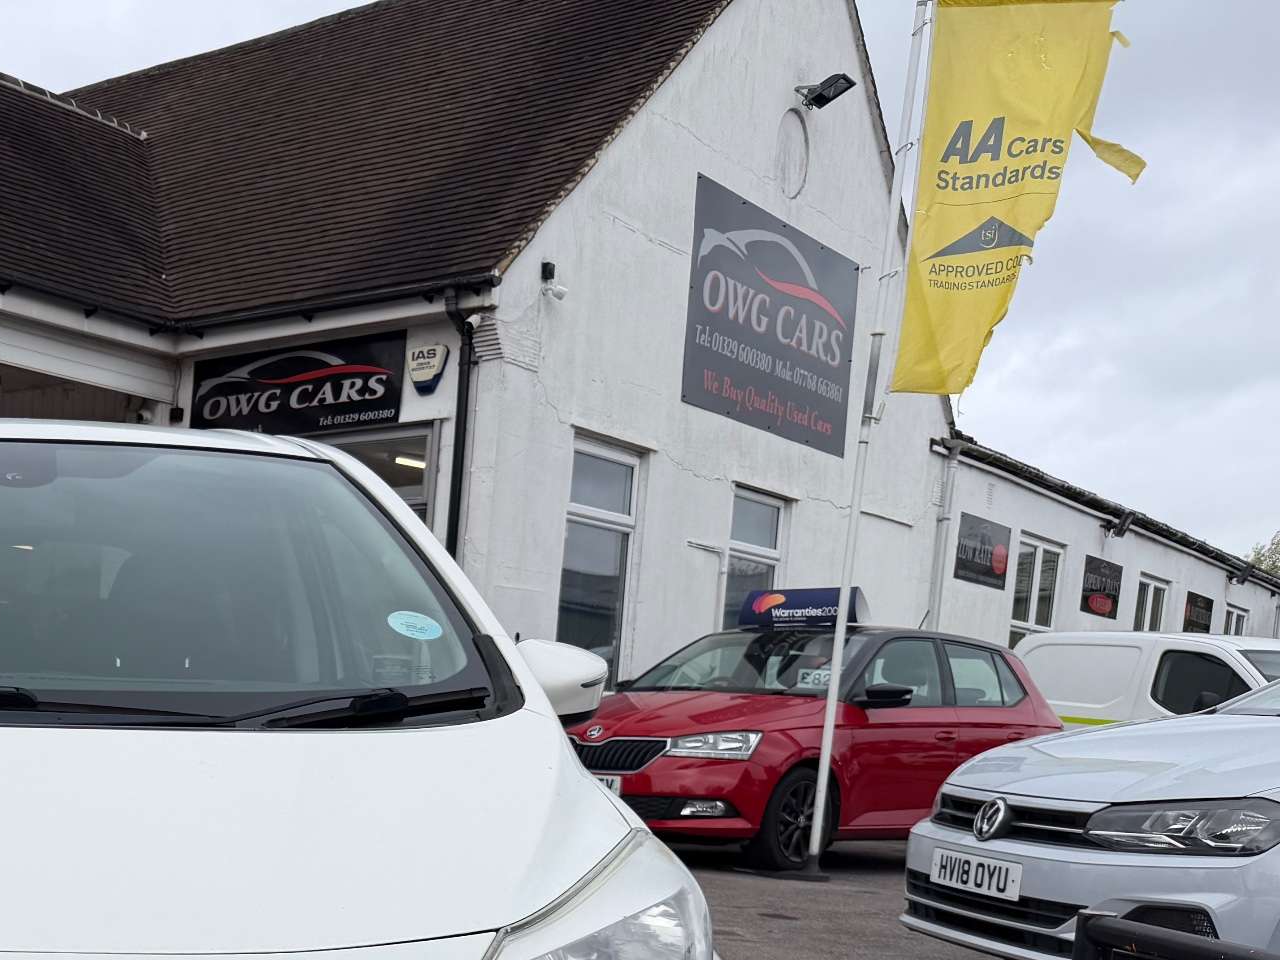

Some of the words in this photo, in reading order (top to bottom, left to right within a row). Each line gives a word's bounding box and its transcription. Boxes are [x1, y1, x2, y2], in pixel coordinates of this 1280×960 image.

[940, 117, 1005, 164] AA
[1006, 136, 1065, 158] Cars
[936, 160, 1061, 191] Standards
[928, 261, 1004, 278] APPROVED
[703, 270, 771, 333] OWG
[776, 306, 843, 368] CARS
[411, 348, 436, 362] IAS
[695, 325, 711, 347] Tel:
[712, 332, 737, 358] 01329
[738, 344, 773, 373] 600380
[202, 389, 281, 420] OWG
[289, 374, 388, 409] CARS
[334, 413, 359, 424] 01329
[360, 408, 395, 422] 600380
[704, 368, 719, 394] We
[722, 376, 743, 412] Buy
[745, 386, 784, 426] Quality
[786, 400, 810, 428] Used
[811, 411, 833, 434] Cars
[771, 606, 839, 618] Warranties200
[938, 854, 971, 885] HV18
[974, 862, 1009, 894] OYU
